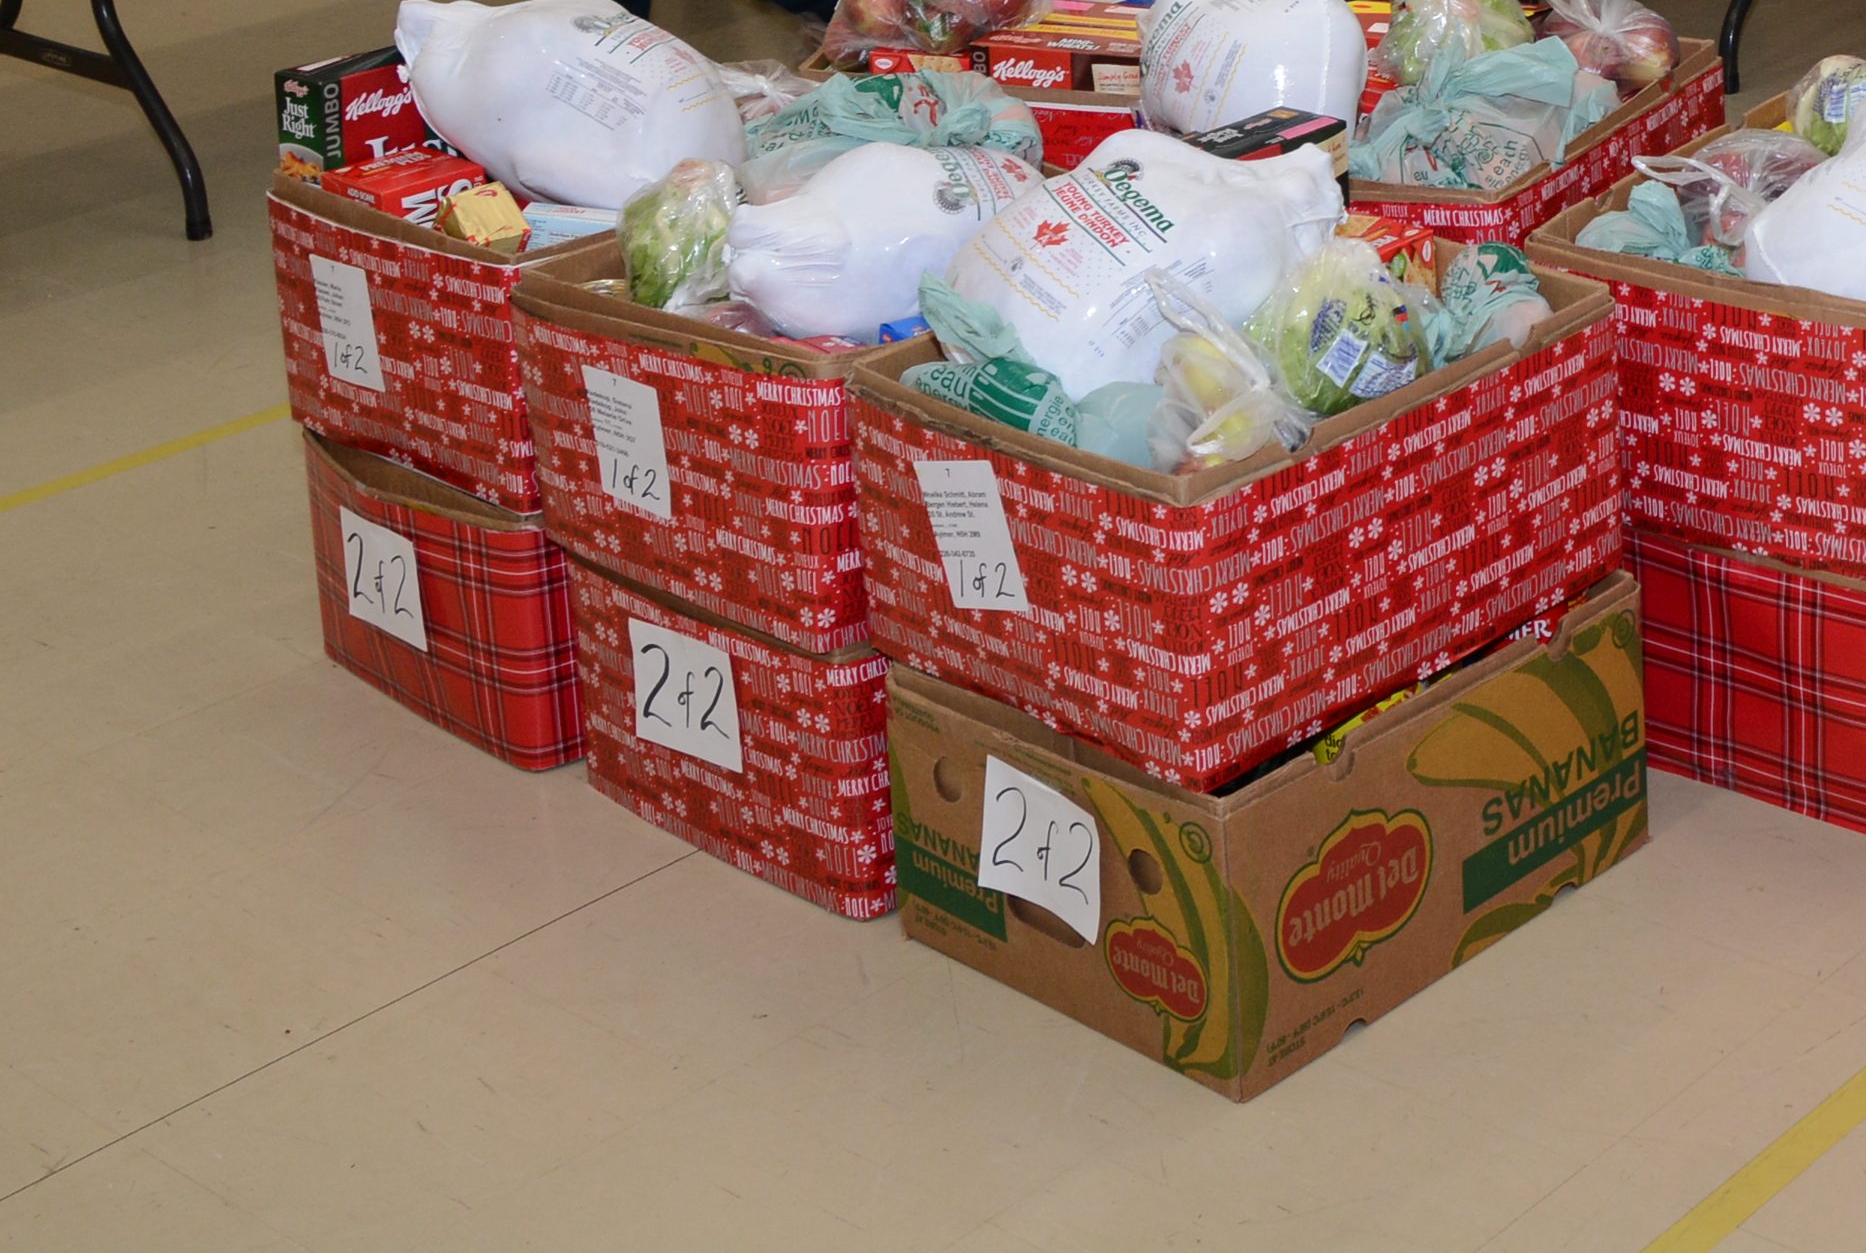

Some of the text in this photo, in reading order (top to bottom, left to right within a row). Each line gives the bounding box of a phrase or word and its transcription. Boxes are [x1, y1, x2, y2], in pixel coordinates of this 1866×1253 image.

[993, 57, 1067, 88] Kellogg's
[282, 114, 317, 139] Right
[285, 97, 309, 118] Just
[323, 83, 342, 159] JUMBO
[345, 87, 412, 121] Kellogg's
[1052, 186, 1119, 249] JEUNE DINDON
[1063, 181, 1131, 245] YOUNG TURKEY
[1423, 207, 1504, 227] MERRY CHRISTMAS
[354, 345, 368, 374] 2
[1720, 326, 1801, 358] MERRY CHRISTMAS
[756, 380, 841, 408] MERRY CHRISTMAS
[1403, 409, 1472, 456] MERRY CHRISTMAS
[612, 458, 661, 501] 1 of 2
[765, 497, 845, 527] MERRY CHRISTMAS
[347, 532, 415, 619] 2 of 2
[972, 562, 987, 598] of
[995, 562, 1015, 599] 2
[641, 643, 730, 739] 2 of 2
[1481, 710, 1639, 837] BANANAS
[1507, 762, 1642, 866] Premium
[992, 787, 1094, 905] 2 of 2
[1325, 839, 1382, 883] Quality
[912, 851, 998, 912] Pemium
[1288, 846, 1419, 947] Del Monte
[1112, 946, 1201, 1004] Del Monte
